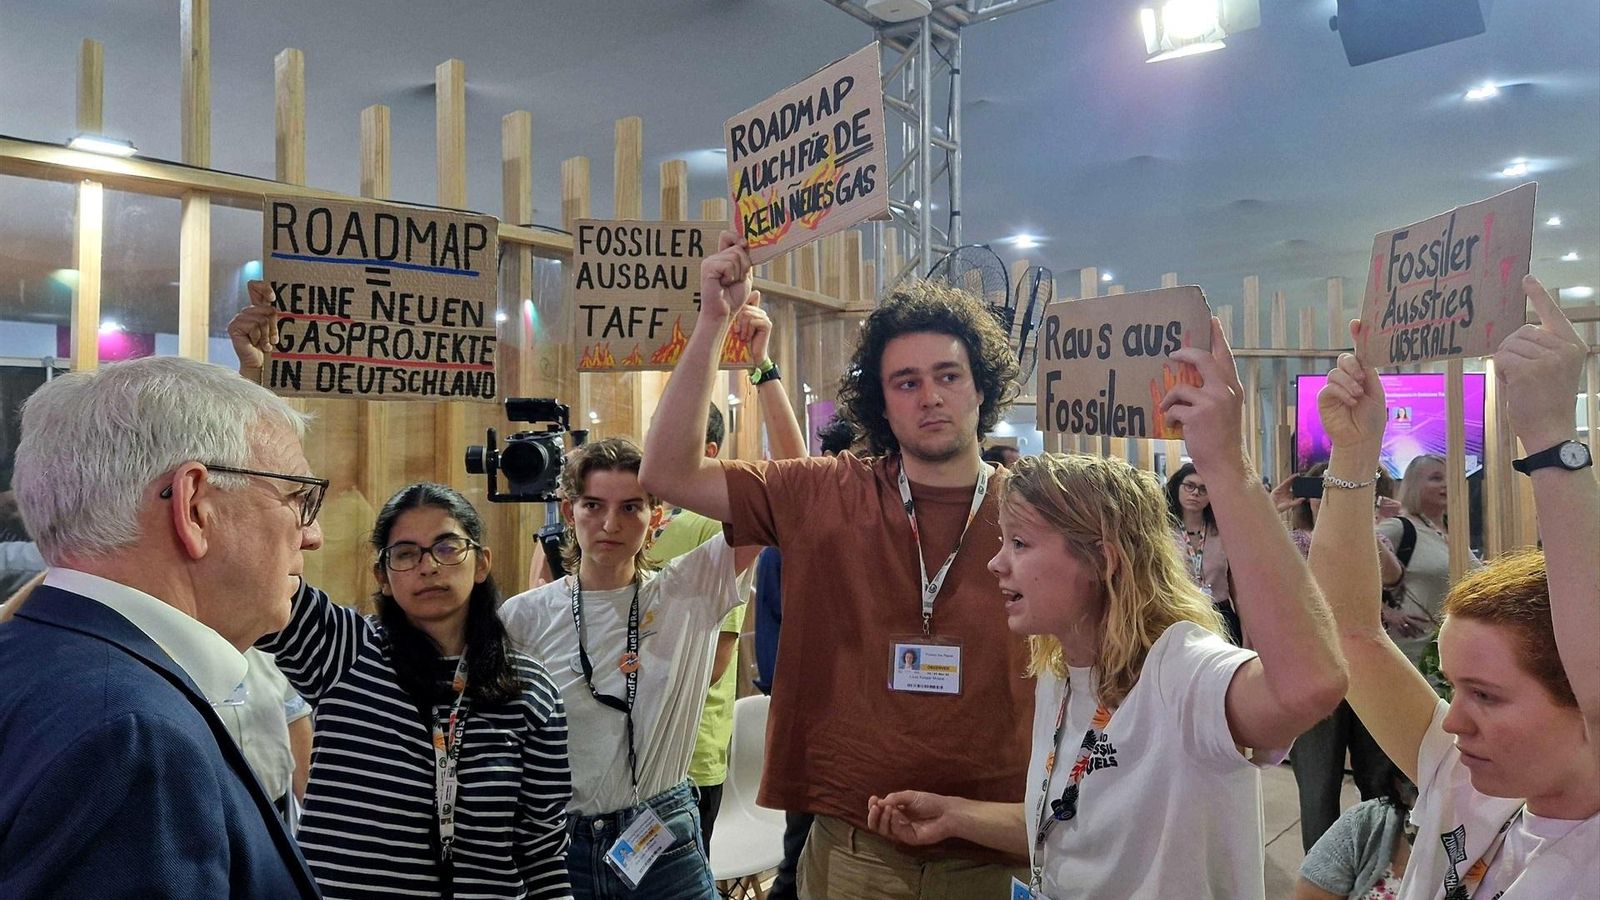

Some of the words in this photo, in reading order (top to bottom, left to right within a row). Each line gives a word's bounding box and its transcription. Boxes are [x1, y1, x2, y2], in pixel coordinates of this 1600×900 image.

[731, 76, 854, 162] ROADMAP
[736, 146, 795, 202] AUCH
[798, 131, 830, 172] FÜR
[833, 108, 871, 155] DE
[744, 196, 785, 240] KEIN
[836, 164, 877, 206] GAS
[272, 202, 488, 270] ROADMAP
[579, 225, 704, 258] FOSSILER
[1387, 213, 1480, 292] Fossiler
[576, 262, 688, 290] AUSBAU
[272, 282, 355, 319] KEINE
[371, 290, 484, 327] NEUEN
[579, 305, 669, 339] TAFF
[1381, 276, 1474, 329] Ausstieg
[276, 317, 496, 366] GASPROJEKTE
[1045, 314, 1112, 361] Raus
[1122, 320, 1182, 358] aus
[270, 360, 302, 390] IN
[316, 362, 496, 399] DEUTSCHLAND
[1046, 369, 1146, 437] Fossilen
[1086, 756, 1118, 775] UELS
[1093, 743, 1117, 757] SSIL
